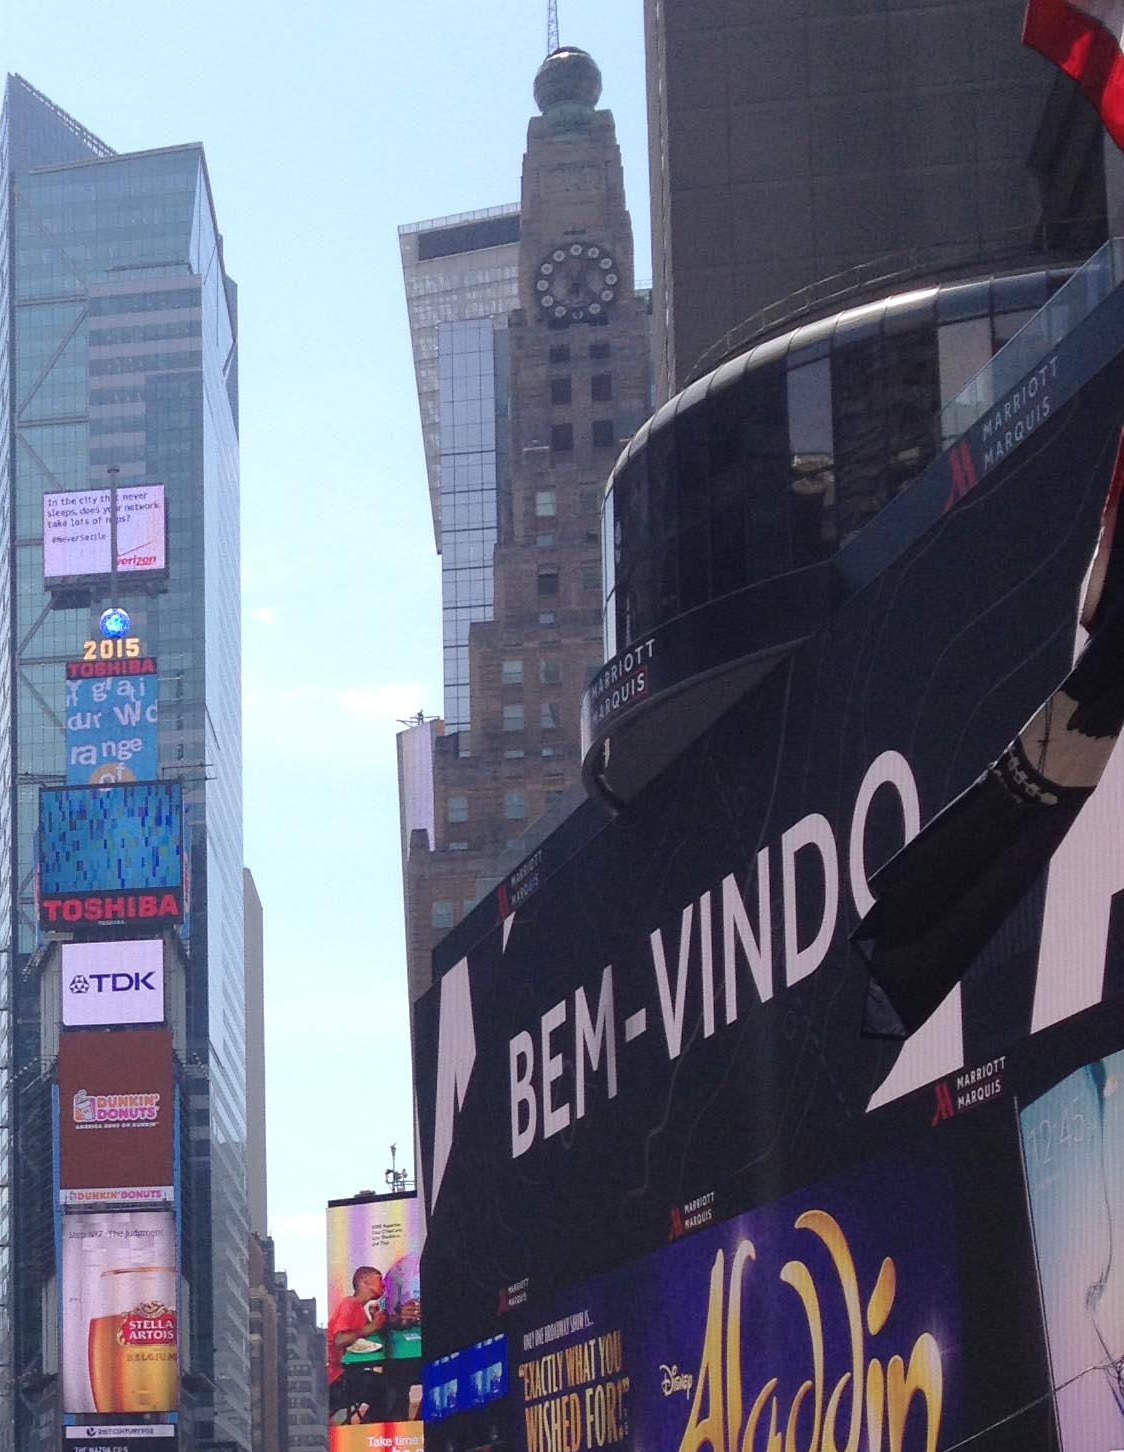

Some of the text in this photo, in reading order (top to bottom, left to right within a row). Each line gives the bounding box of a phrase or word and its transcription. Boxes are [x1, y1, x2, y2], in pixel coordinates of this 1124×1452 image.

[982, 355, 1058, 441] MARRIOTT
[983, 395, 1050, 471] MARQUIS
[82, 637, 140, 660] 2015
[66, 658, 156, 679] TOSHIBA
[43, 894, 180, 922] TOSHIBA
[509, 749, 921, 1161] BEM-VINDO
[89, 971, 156, 993] TDK
[957, 1055, 1006, 1090] MARRIOTT
[97, 1093, 160, 1108] DUNKIN'
[958, 1079, 1002, 1110] MARQUIS
[97, 1107, 157, 1120] DONUTS
[121, 1188, 162, 1199] DONUTS
[684, 1191, 715, 1216] MARRIOTT
[684, 1209, 712, 1230] MARQUIS
[129, 1319, 174, 1330] STELLA
[129, 1329, 175, 1340] ARTOIS
[565, 1338, 596, 1387] WHAT
[598, 1329, 622, 1377] YOU
[367, 1434, 419, 1448] Take time
